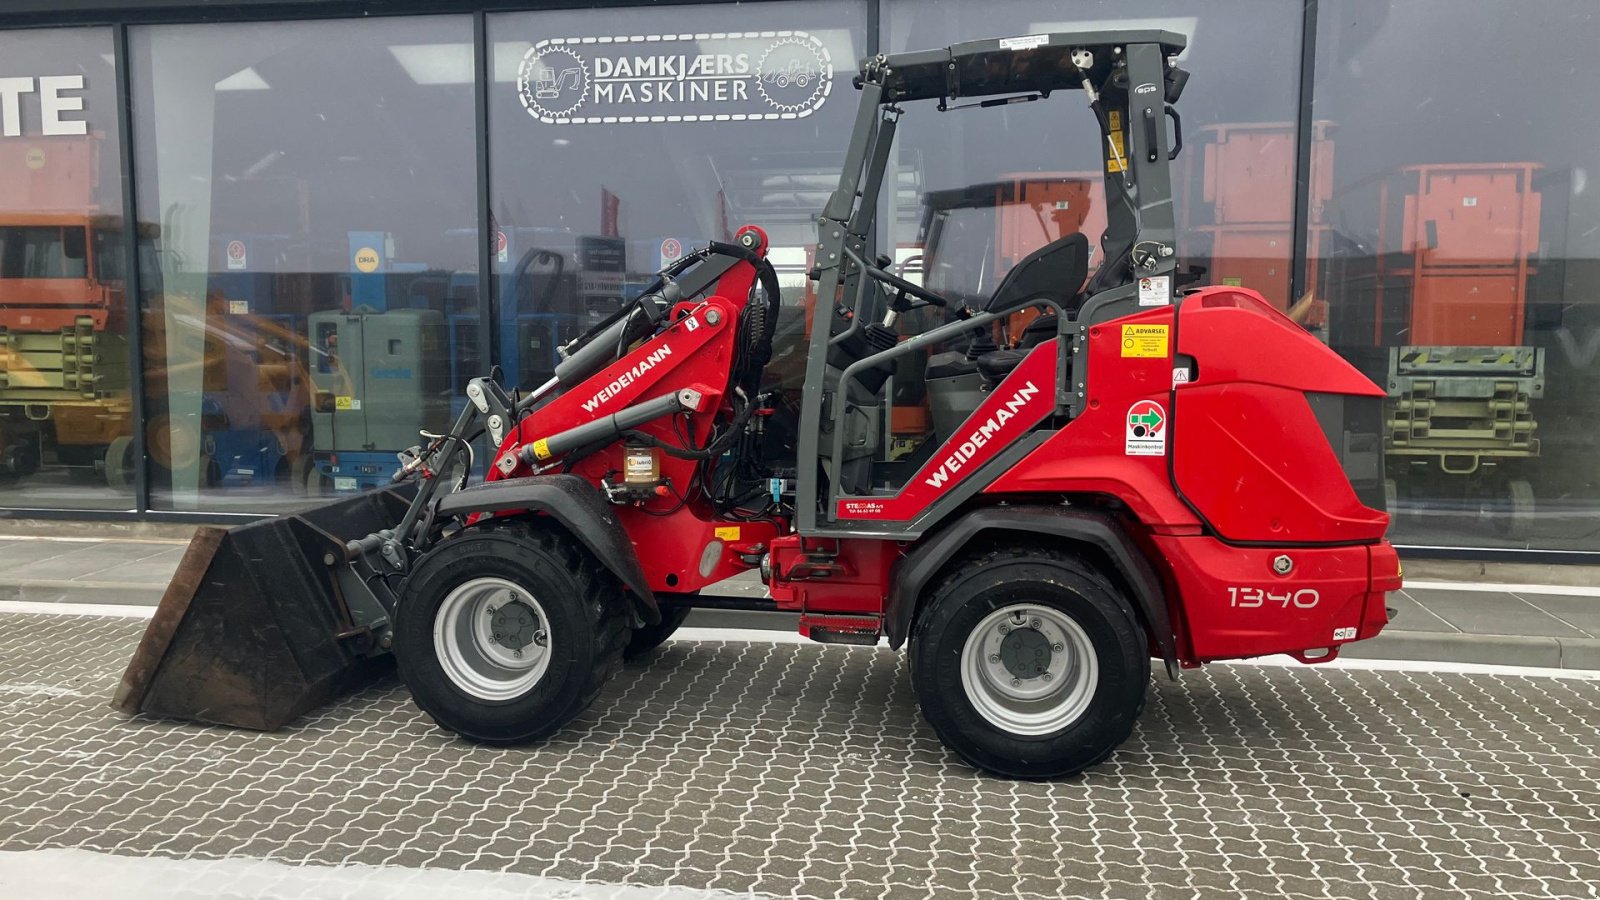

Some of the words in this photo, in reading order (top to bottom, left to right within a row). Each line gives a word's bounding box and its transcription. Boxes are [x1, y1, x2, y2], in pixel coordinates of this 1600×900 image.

[594, 53, 749, 81] DAMKJÆRS
[0, 75, 87, 137] TE
[594, 80, 749, 104] MASKINER
[581, 344, 672, 412] WEIDEMANN
[925, 381, 1040, 489] WEIDEMANN
[1227, 587, 1320, 608] 1340
